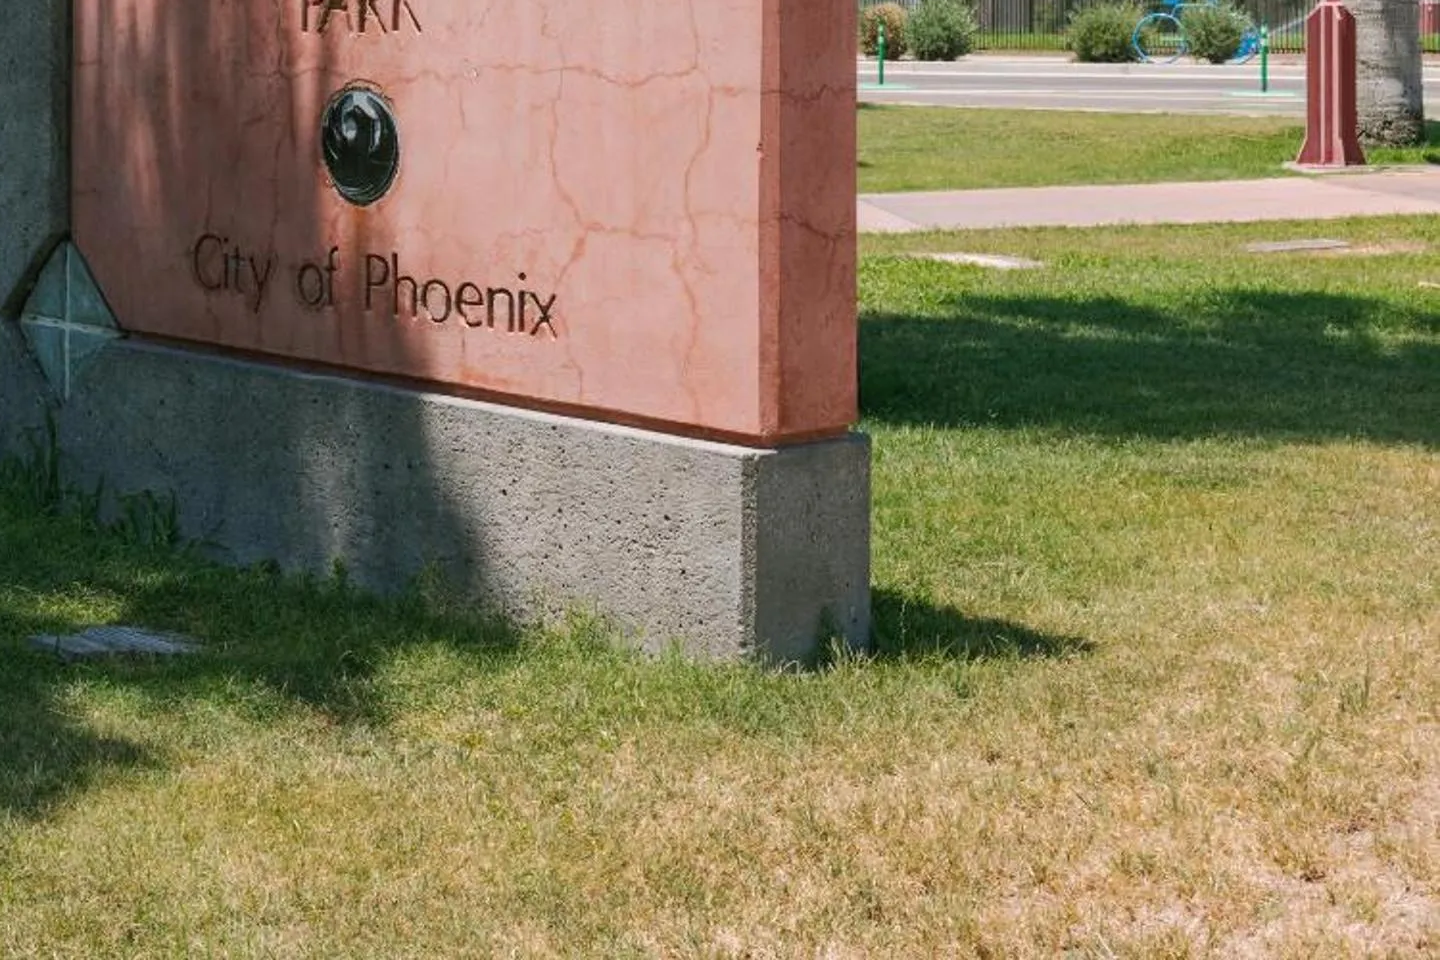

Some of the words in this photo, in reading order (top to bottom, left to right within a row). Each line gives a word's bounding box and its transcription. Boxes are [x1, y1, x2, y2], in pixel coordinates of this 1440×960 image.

[192, 233, 273, 314] City
[297, 246, 339, 307] of
[364, 253, 558, 340] Phoenix
